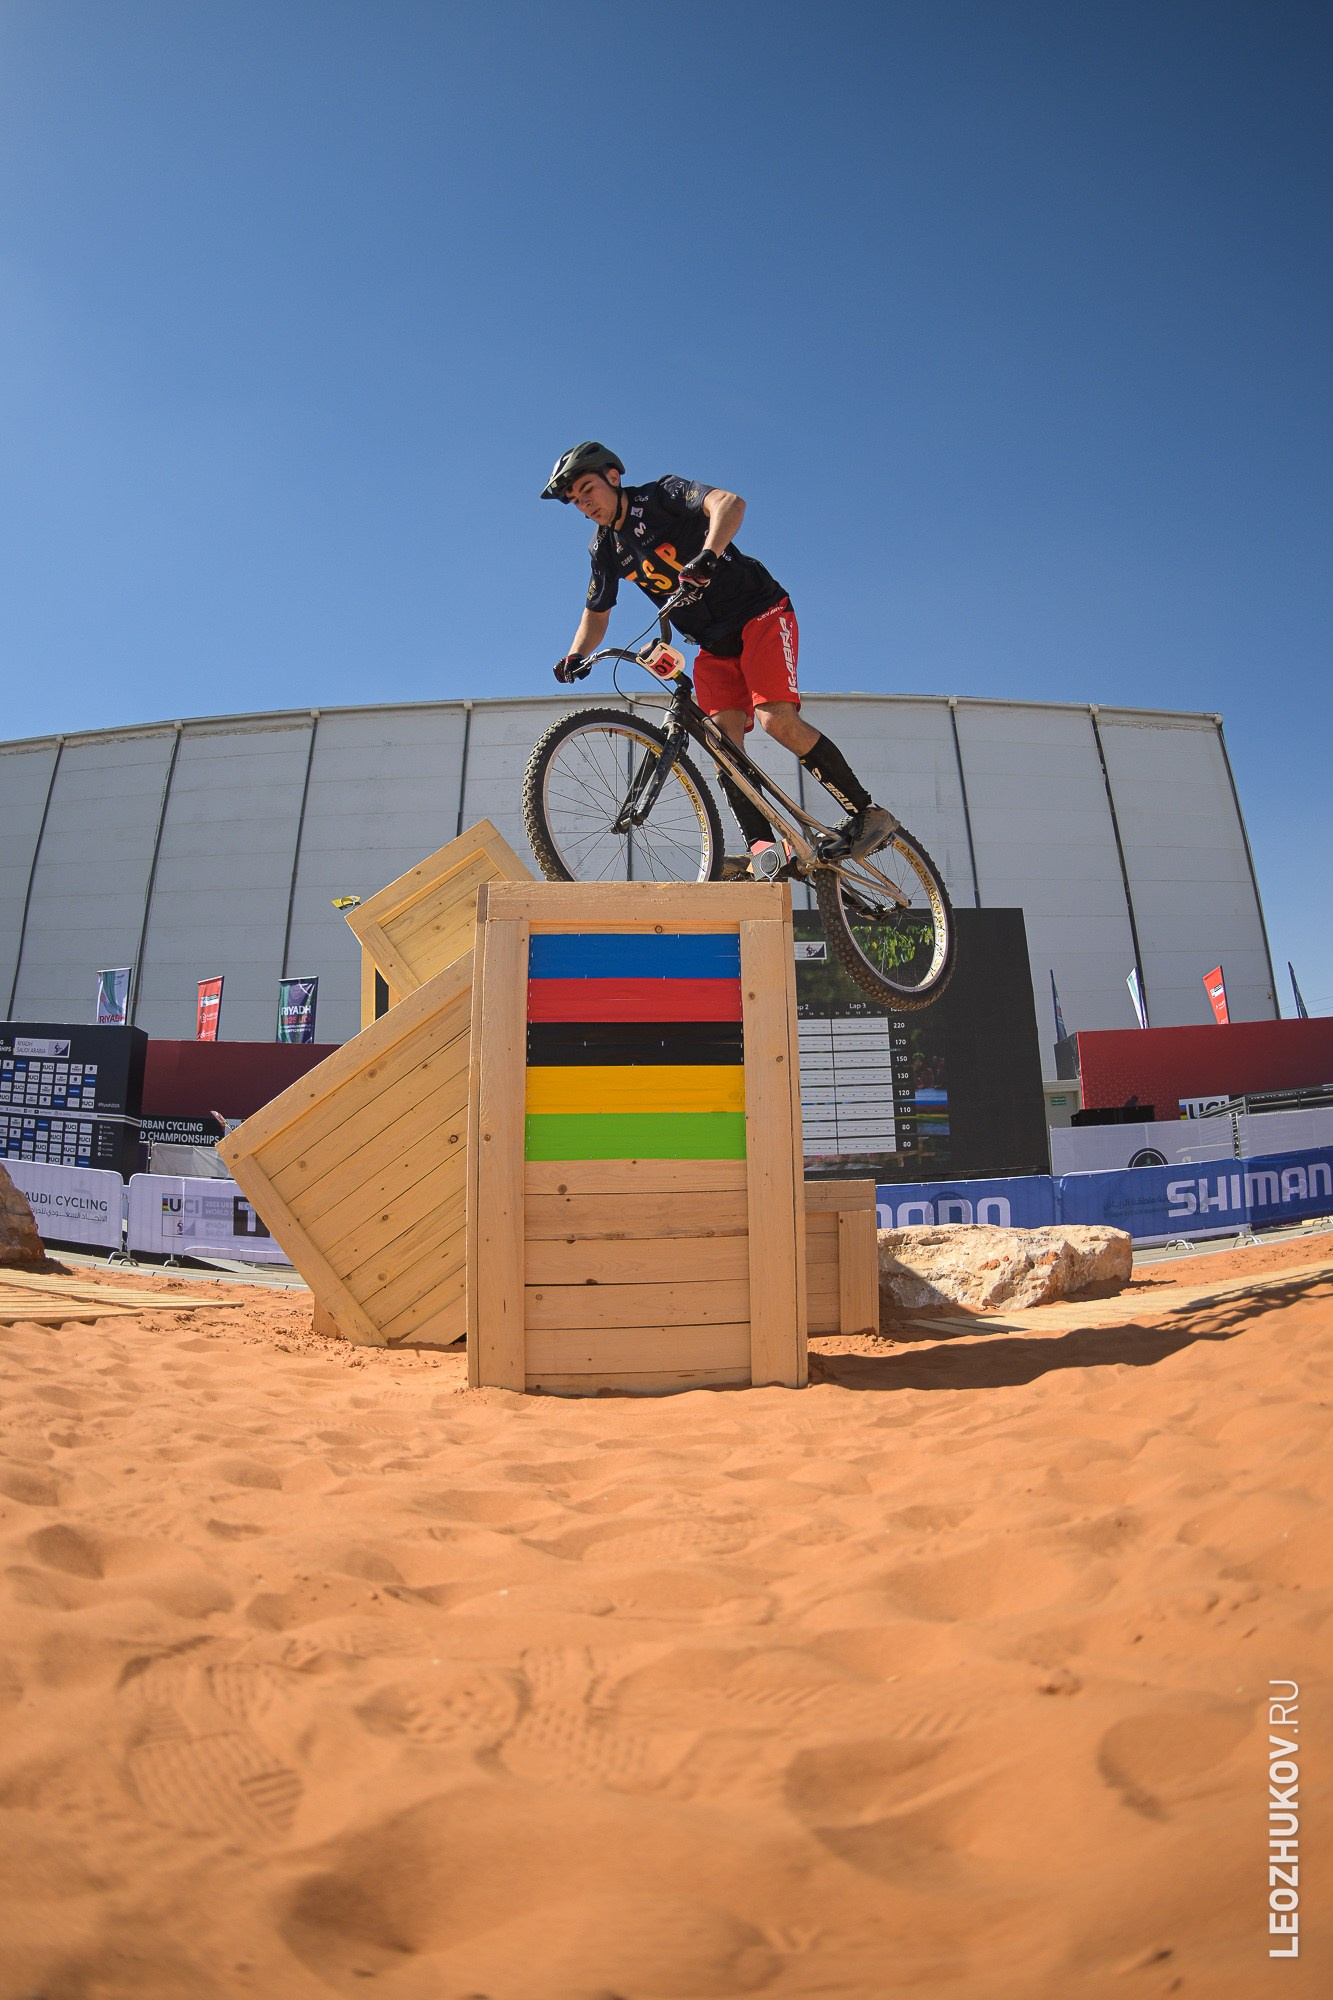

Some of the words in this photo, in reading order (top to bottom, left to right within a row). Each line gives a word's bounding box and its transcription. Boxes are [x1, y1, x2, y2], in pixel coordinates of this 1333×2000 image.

[281, 1005, 312, 1016] RIYADH
[166, 1121, 203, 1132] CYCLING
[148, 1131, 220, 1145] CHAMPIONSHIPS
[55, 1195, 108, 1212] CYCLING
